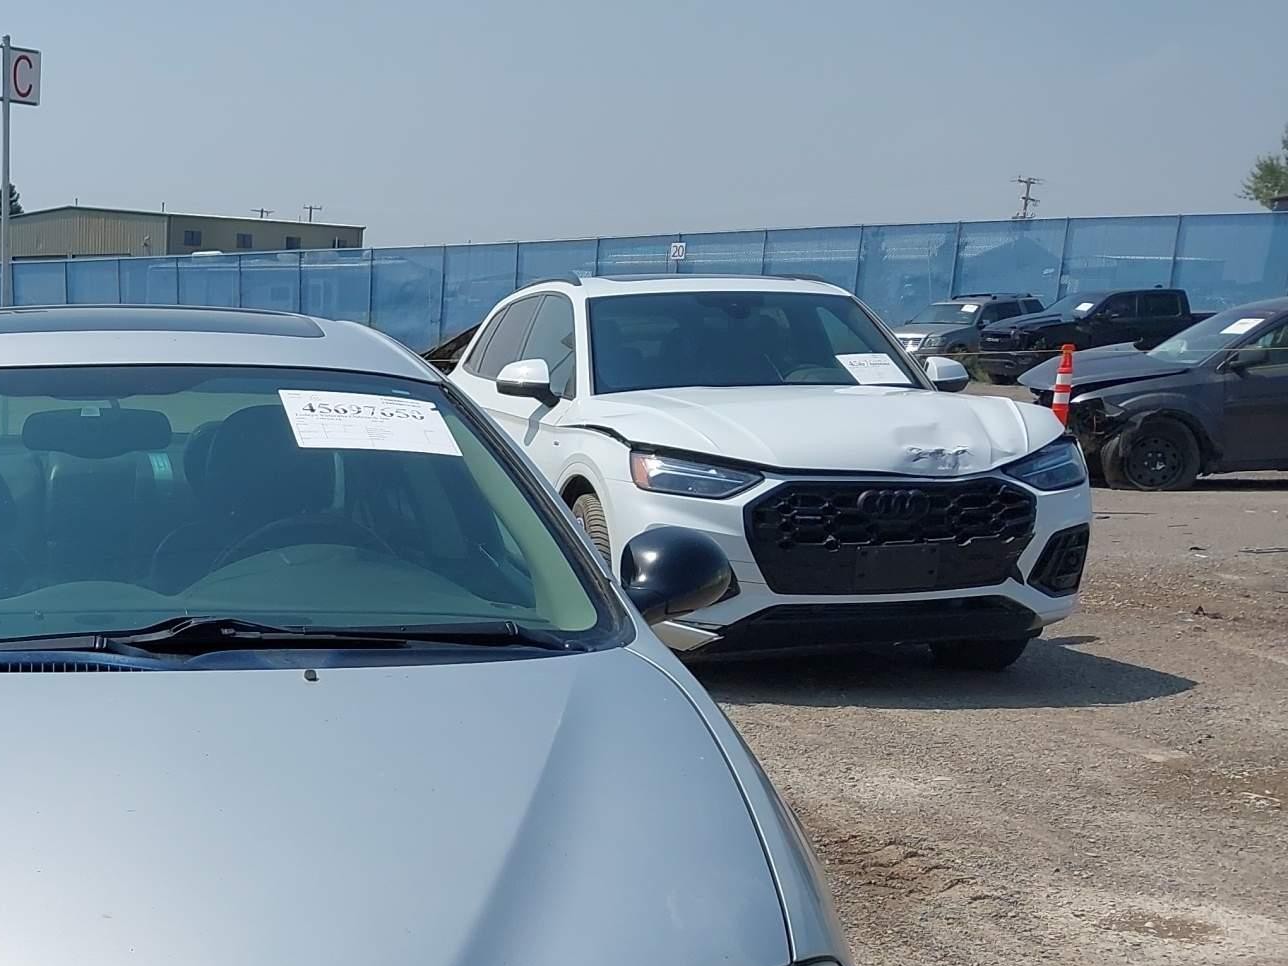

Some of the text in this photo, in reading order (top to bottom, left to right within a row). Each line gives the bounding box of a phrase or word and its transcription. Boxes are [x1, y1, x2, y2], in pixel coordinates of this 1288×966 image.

[13, 54, 33, 98] C
[671, 245, 685, 258] 20
[302, 402, 425, 421] 45697650
